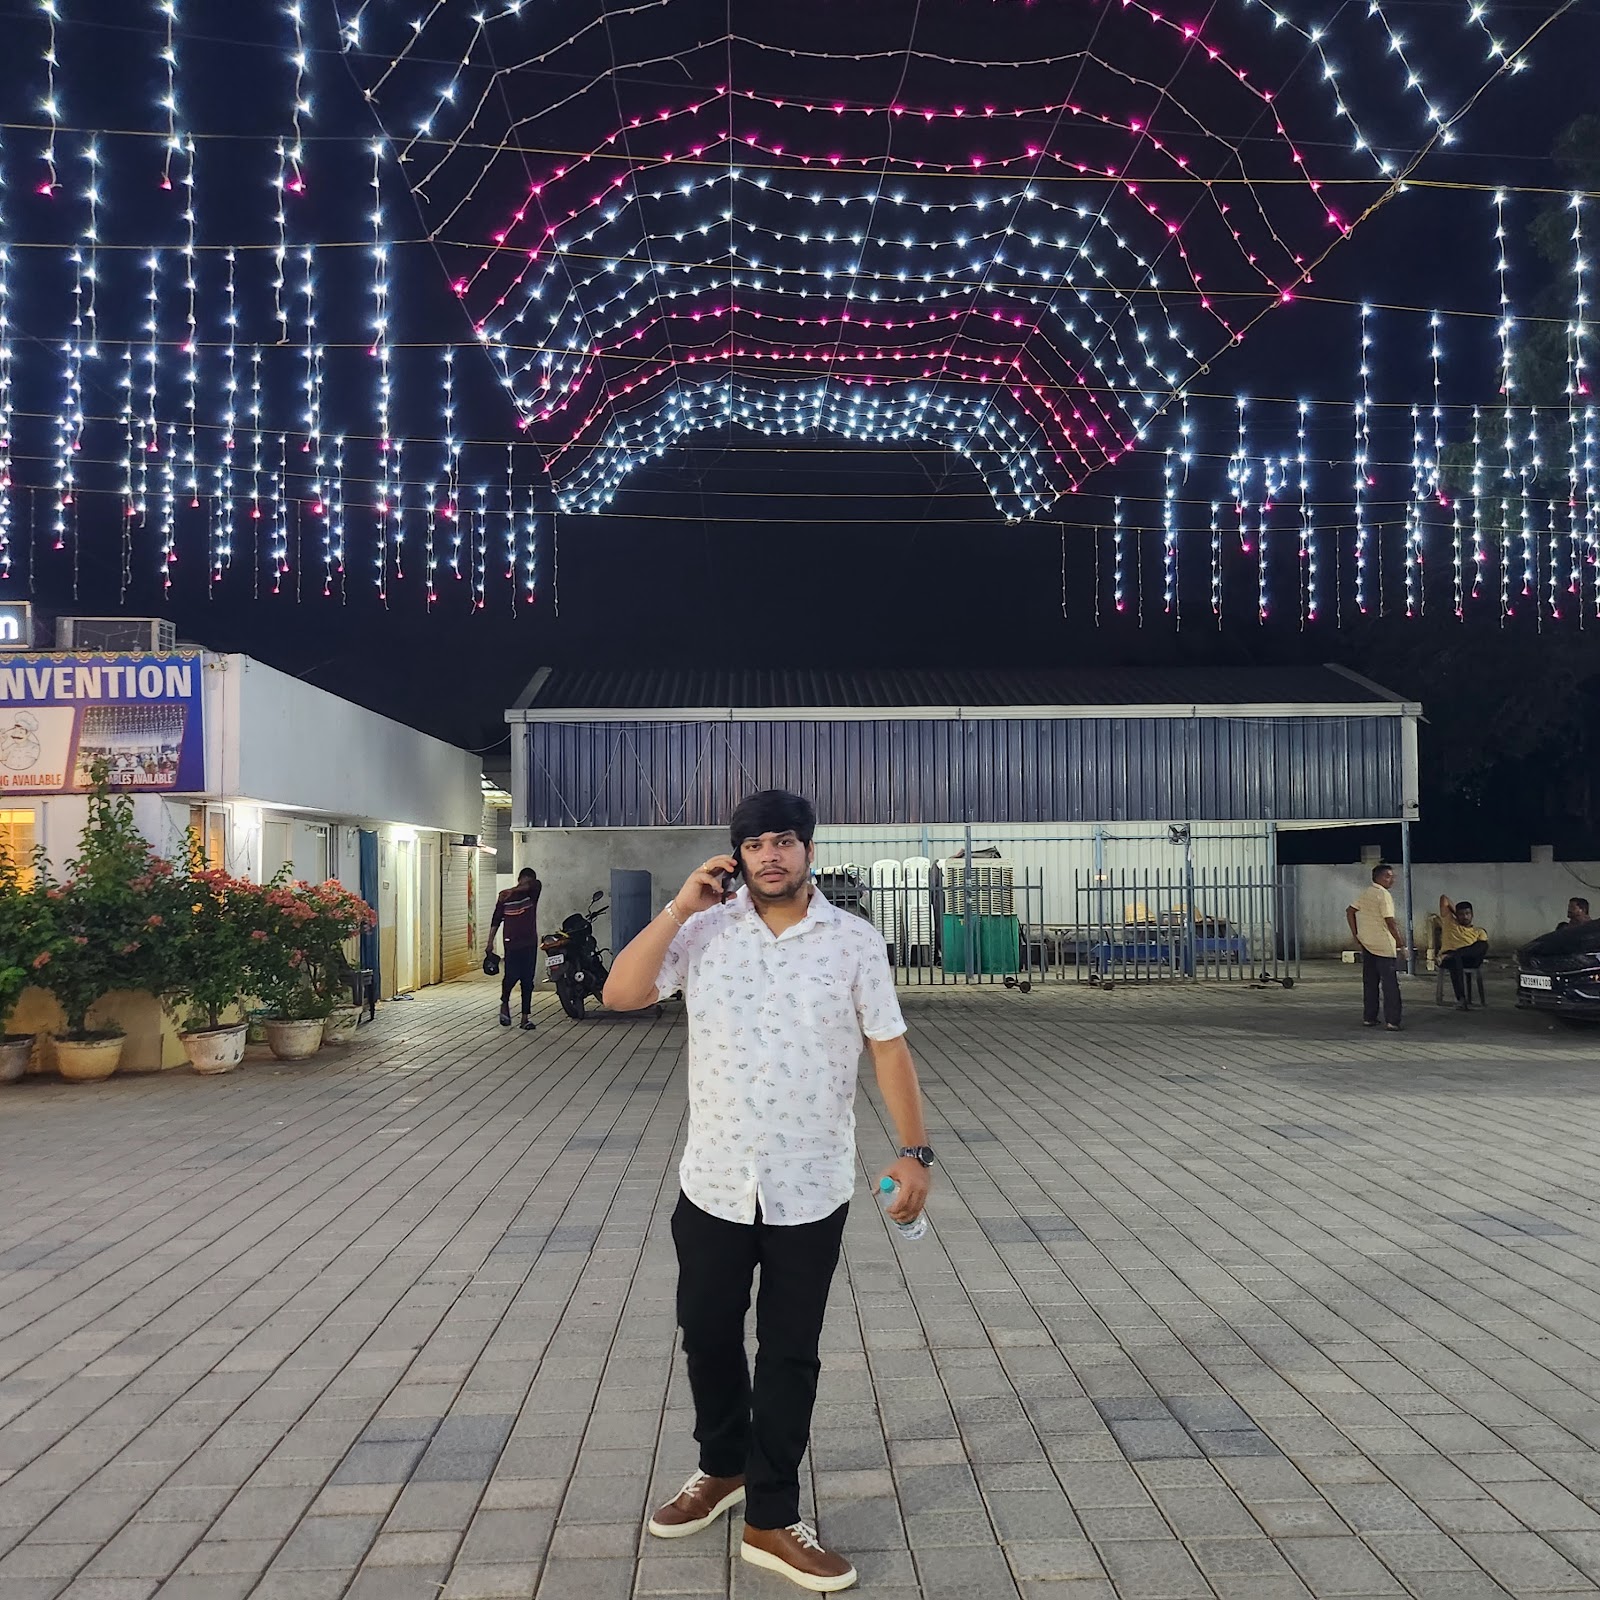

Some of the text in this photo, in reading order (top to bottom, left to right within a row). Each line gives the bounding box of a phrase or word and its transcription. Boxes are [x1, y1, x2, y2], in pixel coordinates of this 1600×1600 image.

[0, 665, 192, 700] NVENTION
[12, 773, 62, 786] AVAILABLE
[133, 773, 173, 785] AVAILABLE
